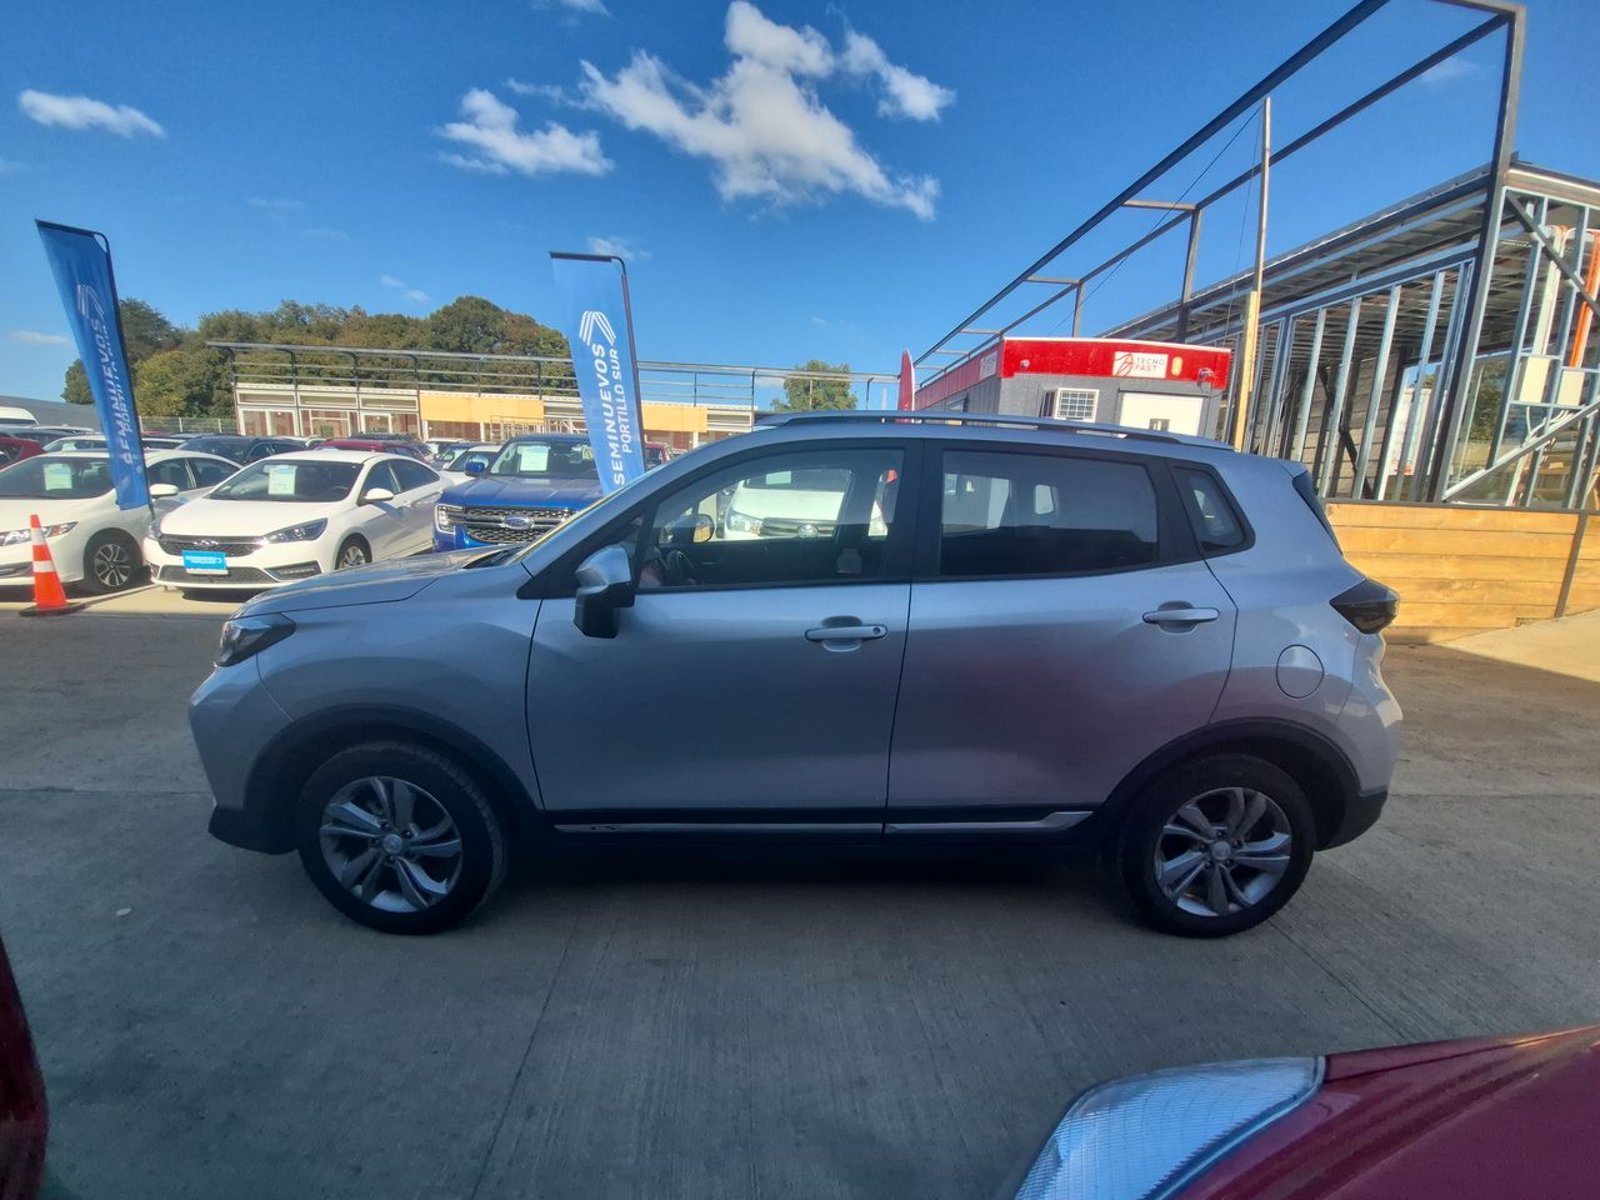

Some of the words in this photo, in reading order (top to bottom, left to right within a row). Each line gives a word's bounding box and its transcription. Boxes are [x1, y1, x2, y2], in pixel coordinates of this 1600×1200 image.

[609, 348, 622, 381] SUR
[1136, 357, 1165, 365] TECNO
[592, 343, 626, 486] SEMINUEVOS
[614, 384, 632, 454] PORTILLO
